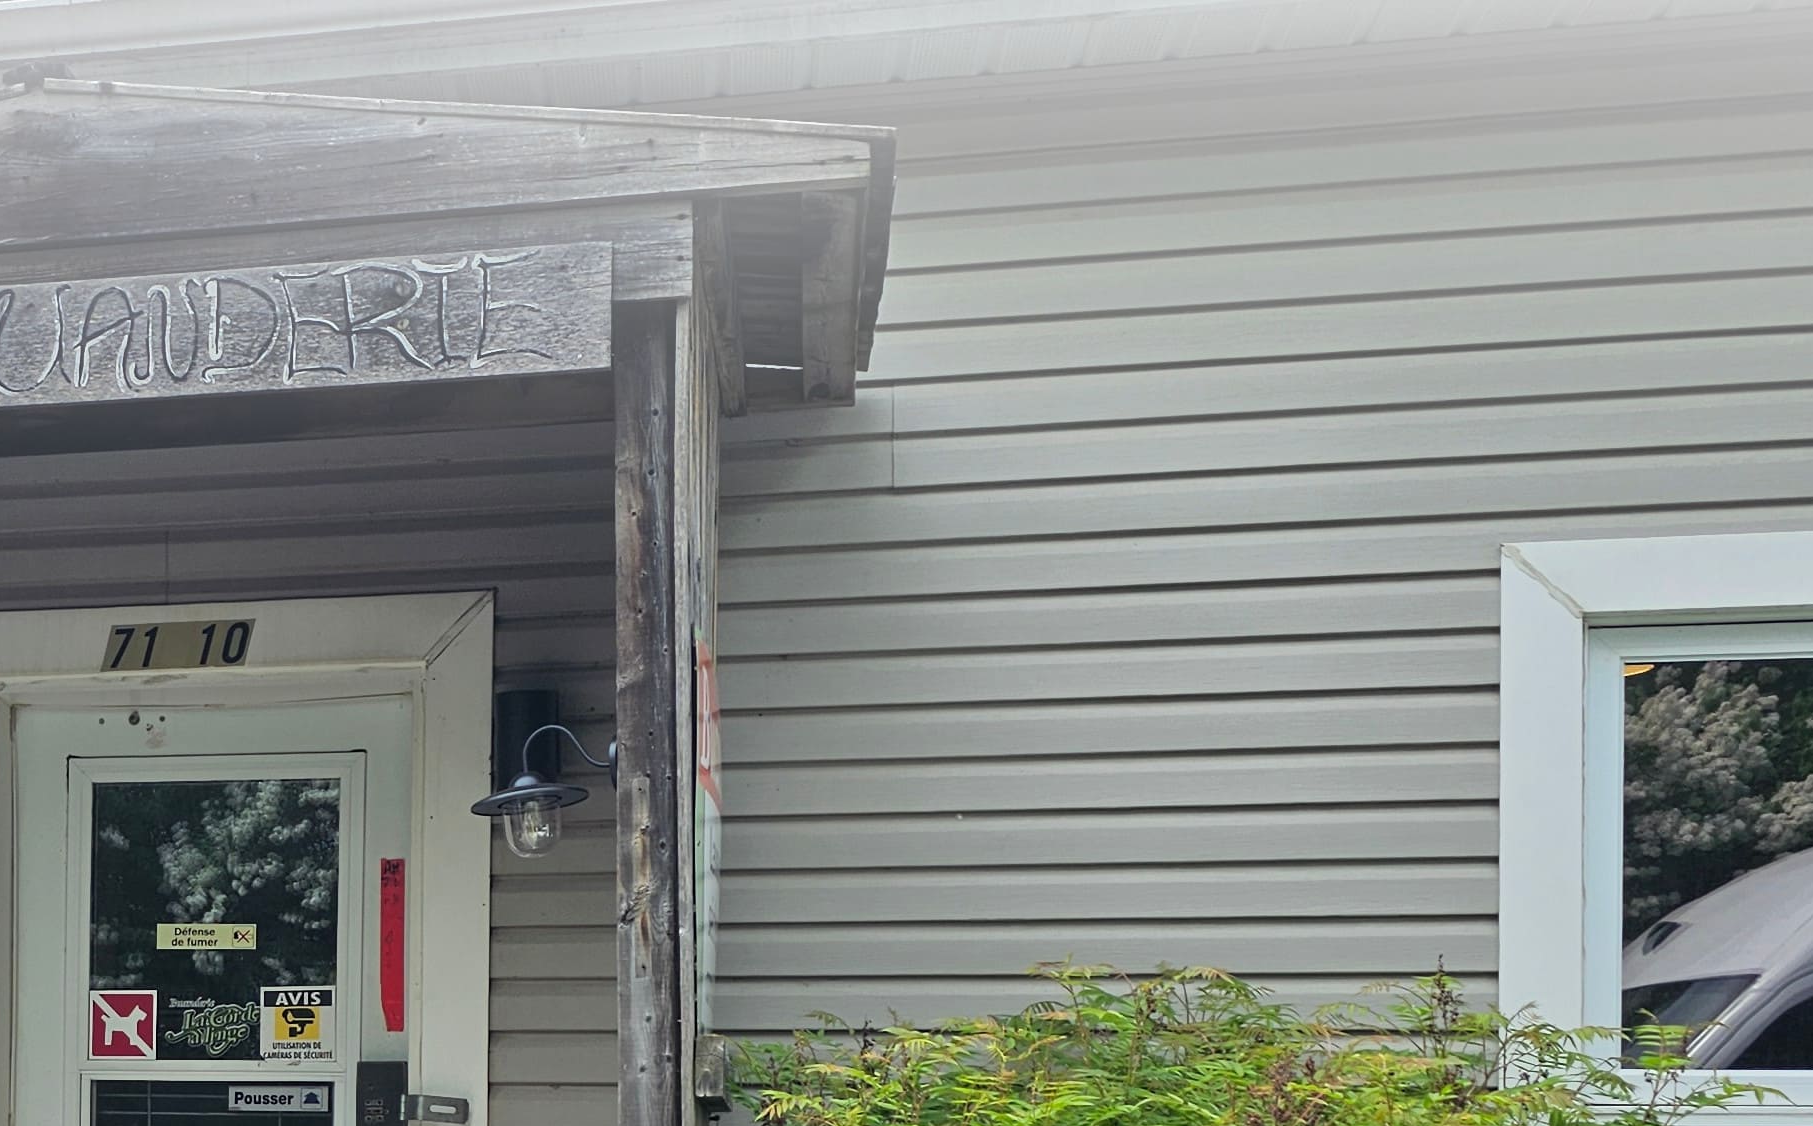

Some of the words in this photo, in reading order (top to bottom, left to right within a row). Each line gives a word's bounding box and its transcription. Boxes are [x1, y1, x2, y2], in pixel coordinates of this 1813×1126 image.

[110, 627, 159, 669] 71
[199, 621, 250, 665] 10
[174, 926, 216, 937] Défense
[171, 937, 185, 947] de
[187, 937, 218, 947] fumer
[276, 991, 322, 1006] AVIS
[272, 1041, 313, 1050] UTILISATION
[314, 1041, 322, 1050] DE
[294, 1051, 303, 1060] DE
[304, 1049, 334, 1060] SÉCURITÉ
[234, 1091, 295, 1105] Pousser
